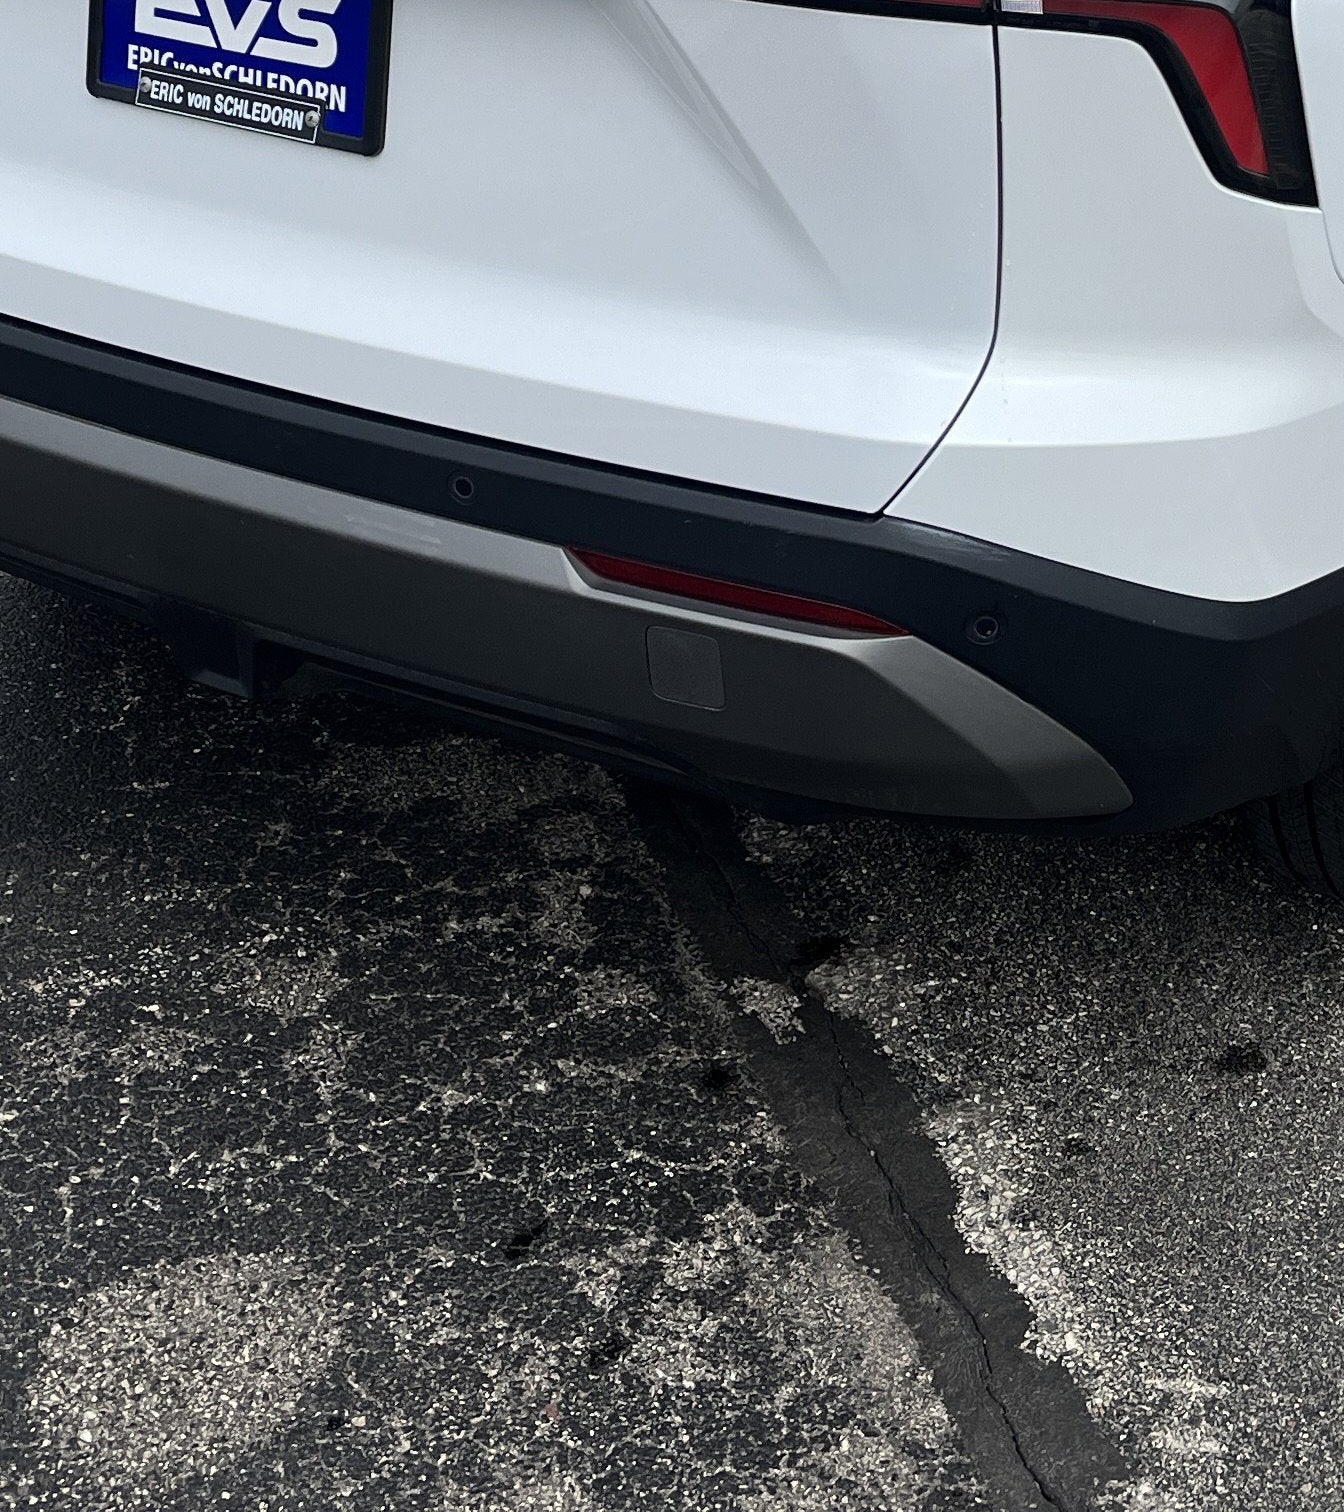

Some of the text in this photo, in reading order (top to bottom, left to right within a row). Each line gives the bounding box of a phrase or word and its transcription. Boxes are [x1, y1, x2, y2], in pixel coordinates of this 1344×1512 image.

[149, 79, 304, 131] ERIC von SCHLEDORN
